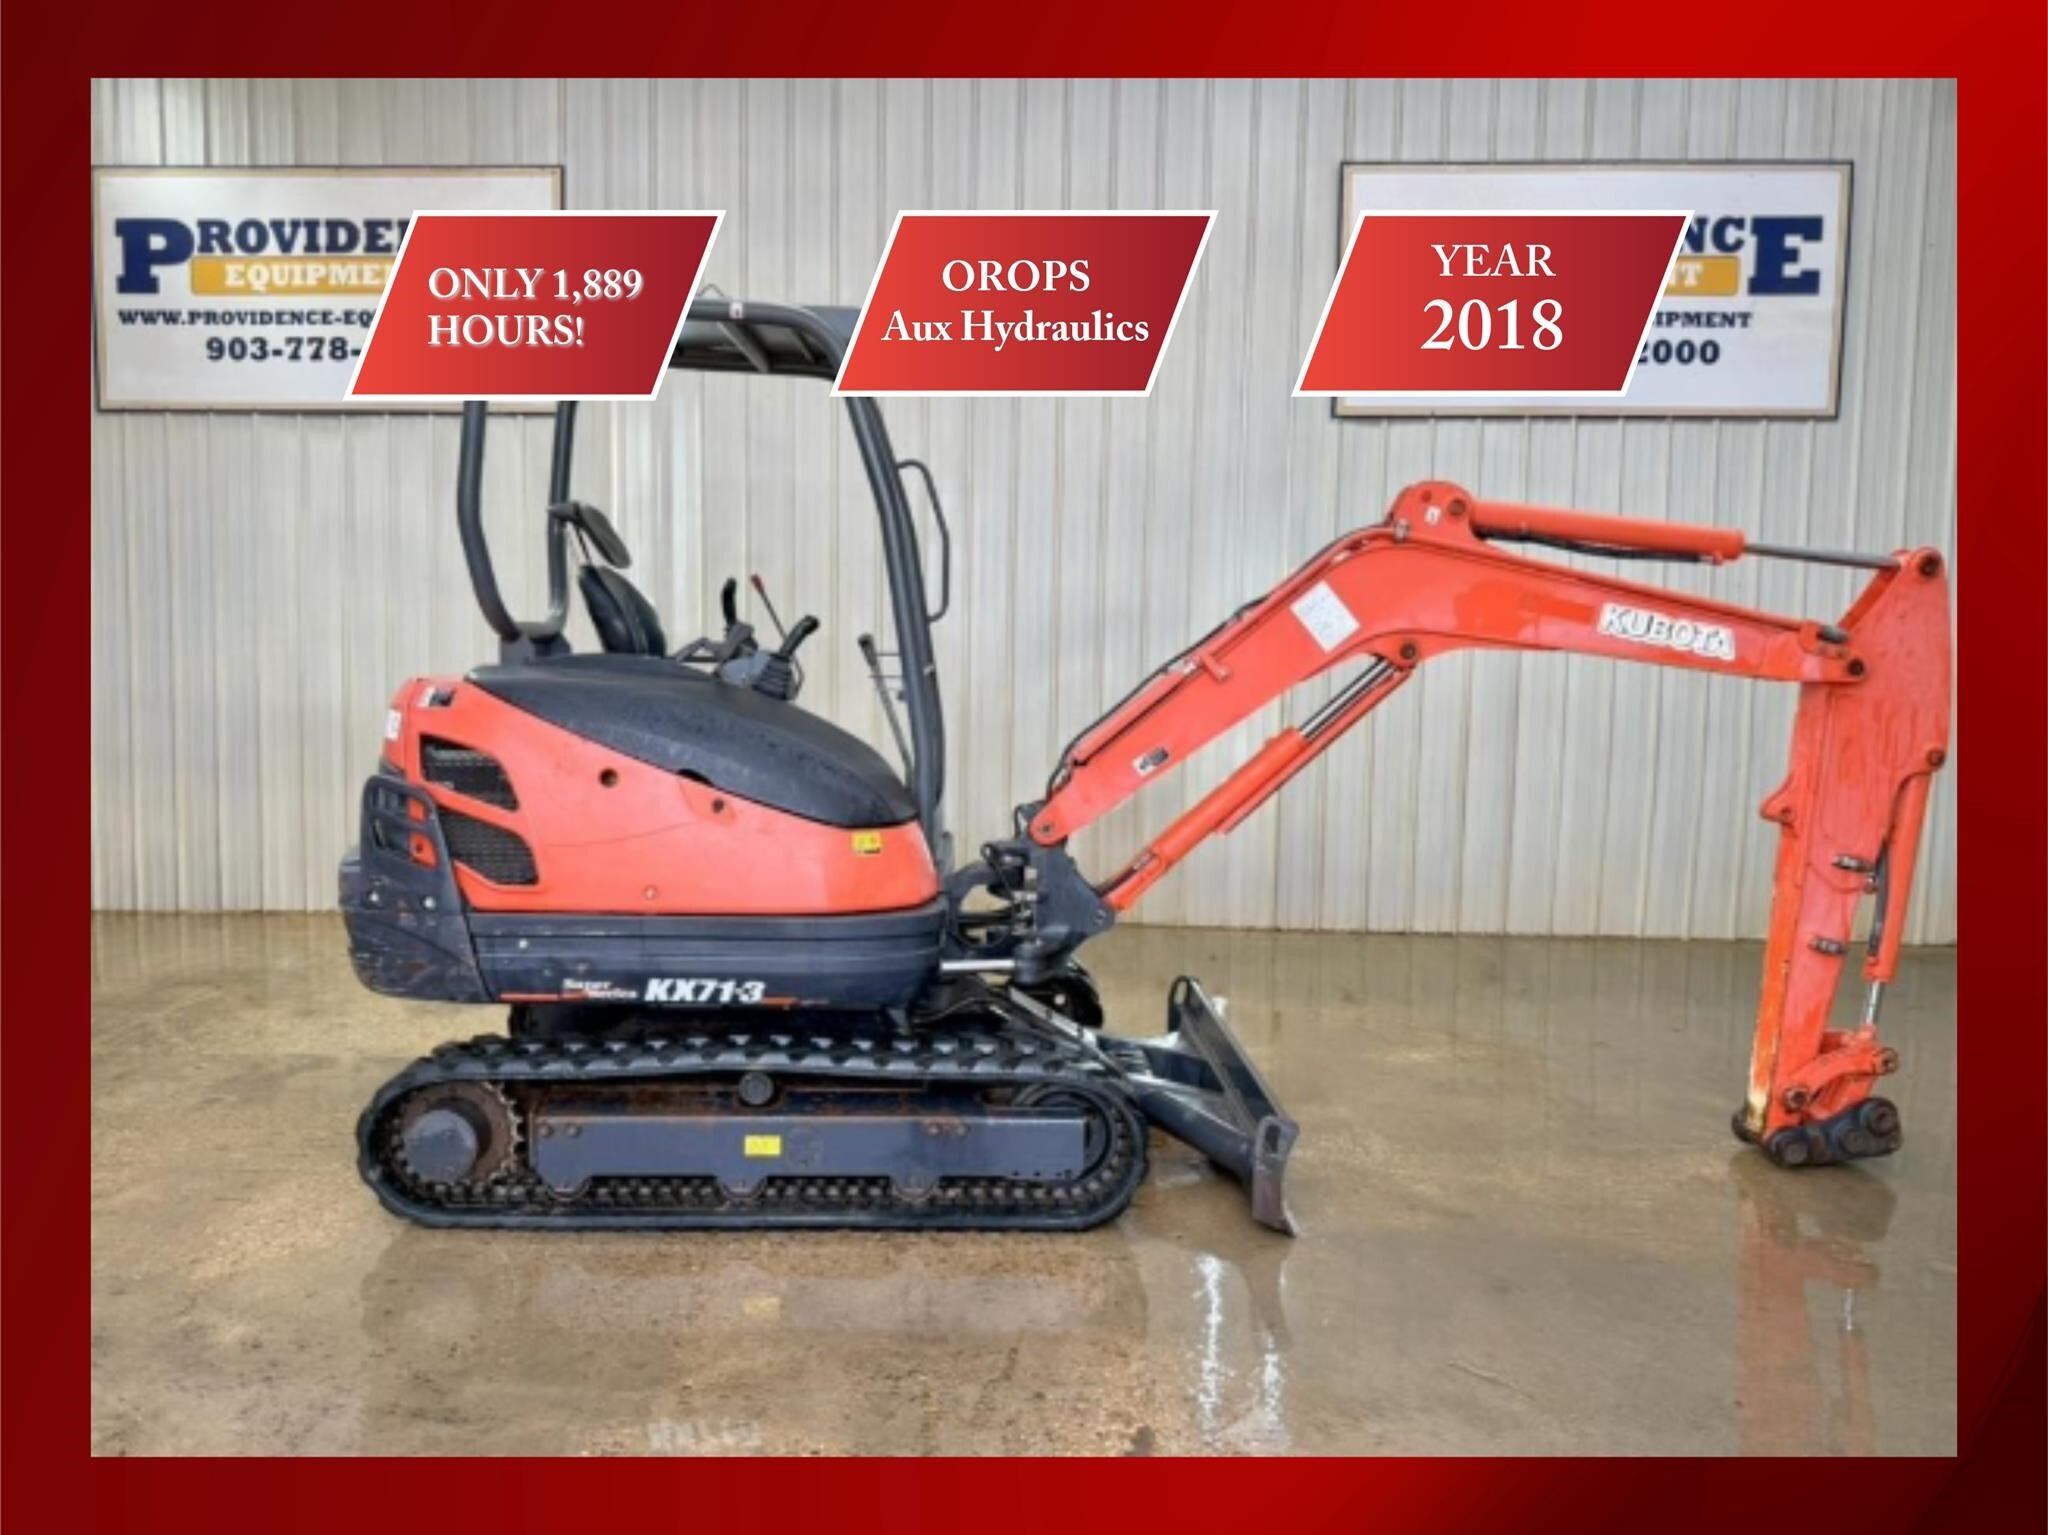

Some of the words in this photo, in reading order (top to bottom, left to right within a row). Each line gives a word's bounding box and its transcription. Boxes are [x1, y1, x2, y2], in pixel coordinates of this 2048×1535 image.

[224, 263, 392, 291] EQUIPME
[118, 310, 377, 328] WWW.PROVIDENCE-EQ
[1653, 311, 1753, 328] IPMENT
